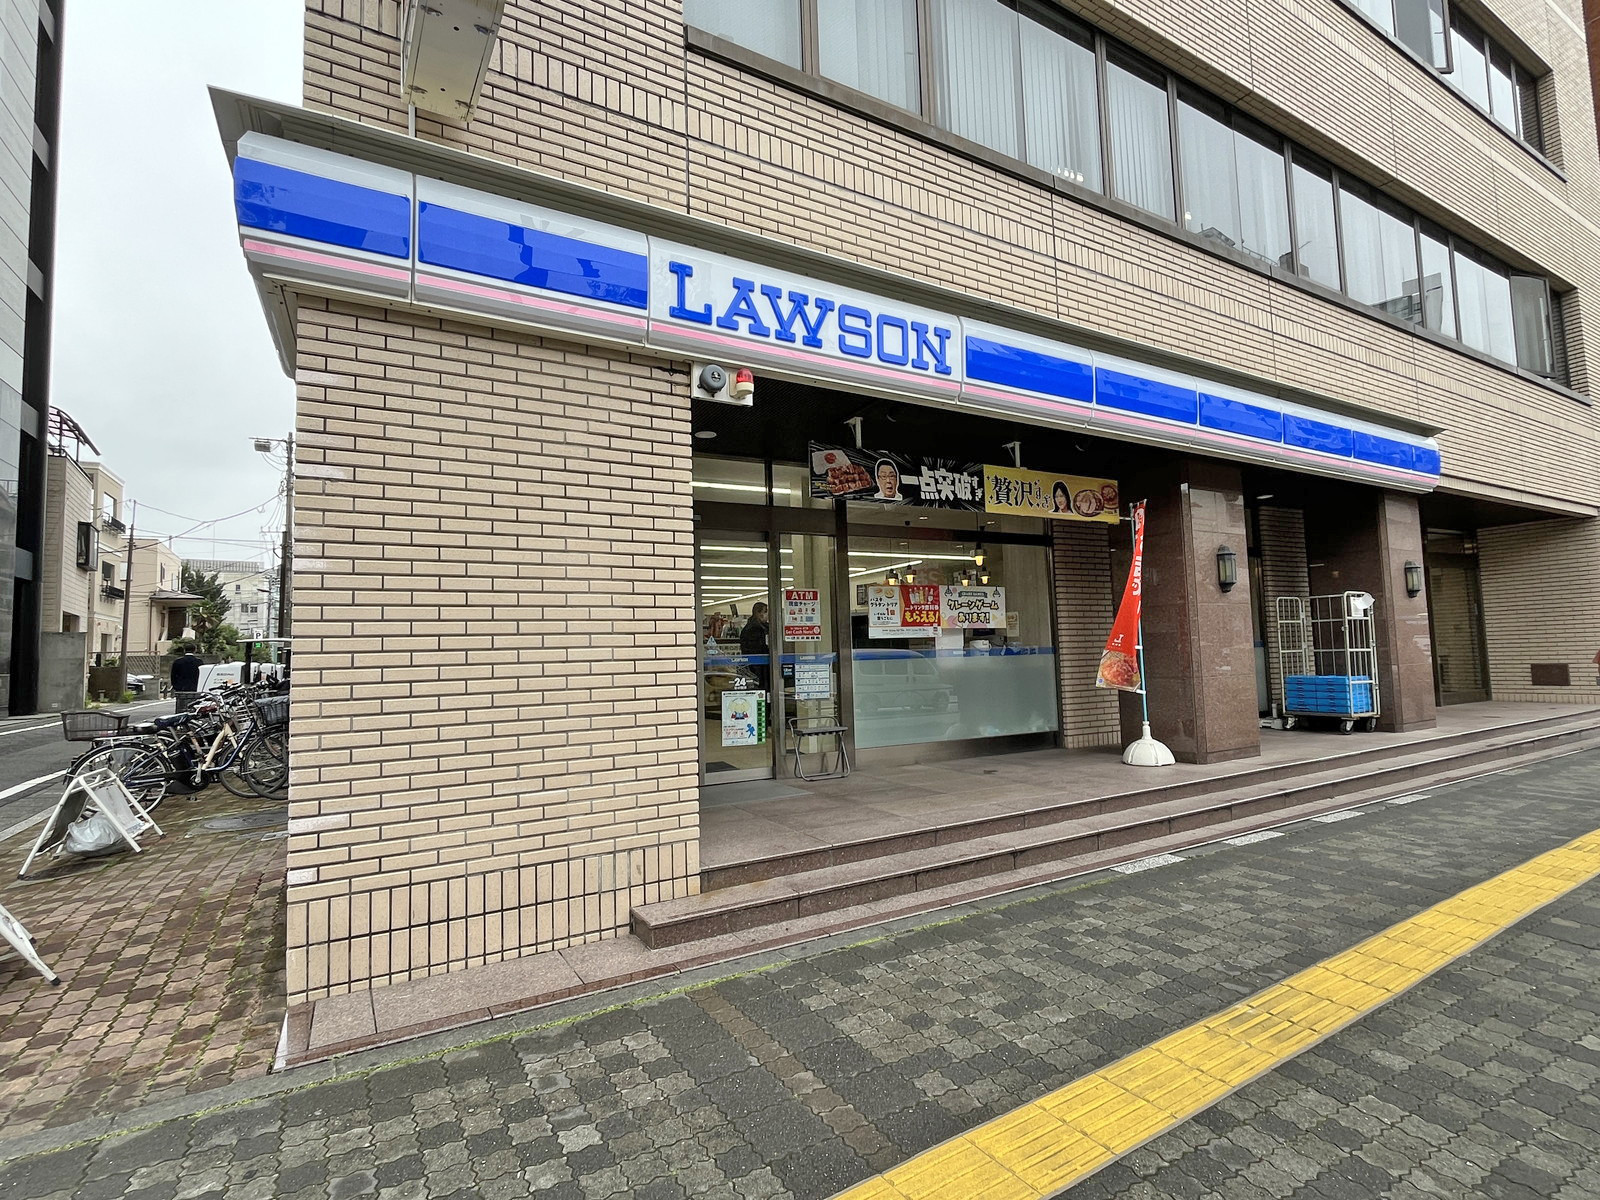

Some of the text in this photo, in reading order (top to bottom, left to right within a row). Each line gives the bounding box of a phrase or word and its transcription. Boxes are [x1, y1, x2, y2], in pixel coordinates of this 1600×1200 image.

[668, 260, 951, 375] LAWSON
[900, 465, 983, 501] 一点突破すぎ
[991, 474, 1050, 508] 贅沢すぎ
[791, 591, 813, 600] ATM
[947, 599, 999, 610] クレーンゲーム
